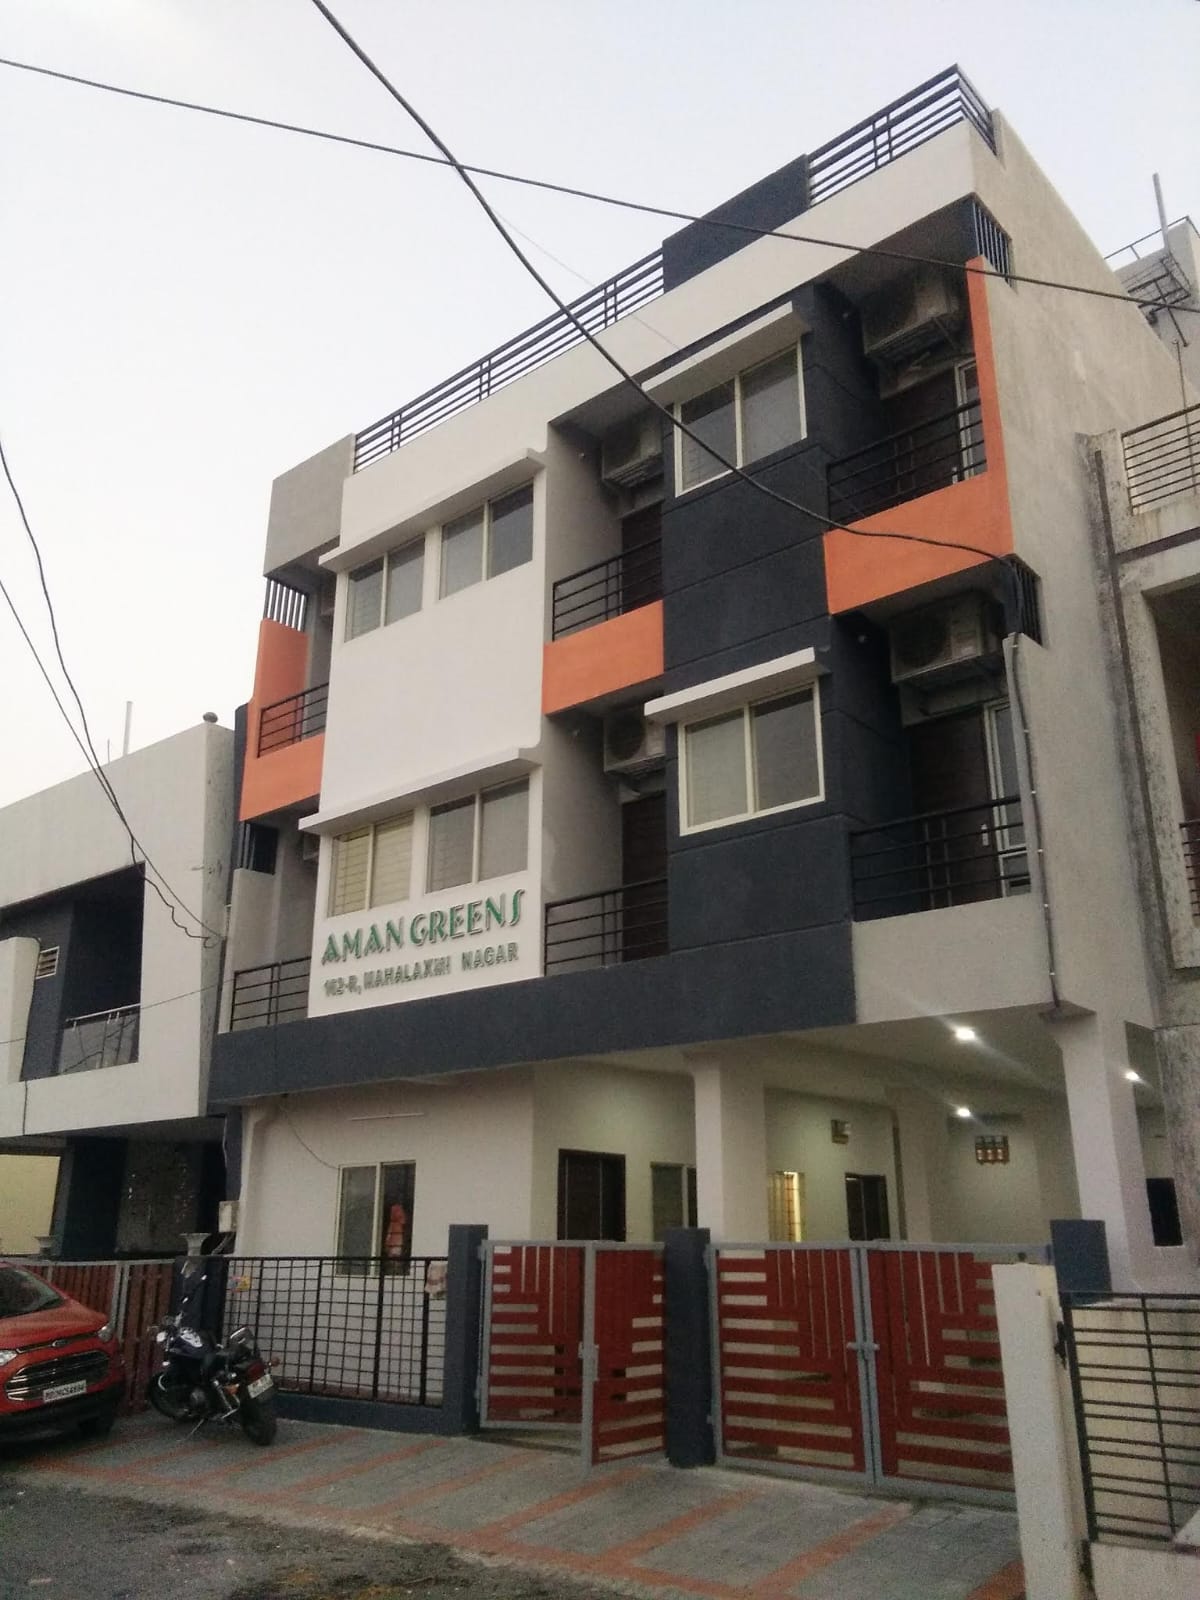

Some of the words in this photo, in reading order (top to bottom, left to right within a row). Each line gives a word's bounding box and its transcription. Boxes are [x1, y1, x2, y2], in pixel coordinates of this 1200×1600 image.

[321, 915, 404, 966] AMAN
[409, 889, 525, 947] GREENS
[363, 955, 451, 990] MAHALAXMI
[461, 941, 519, 971] NAGAR
